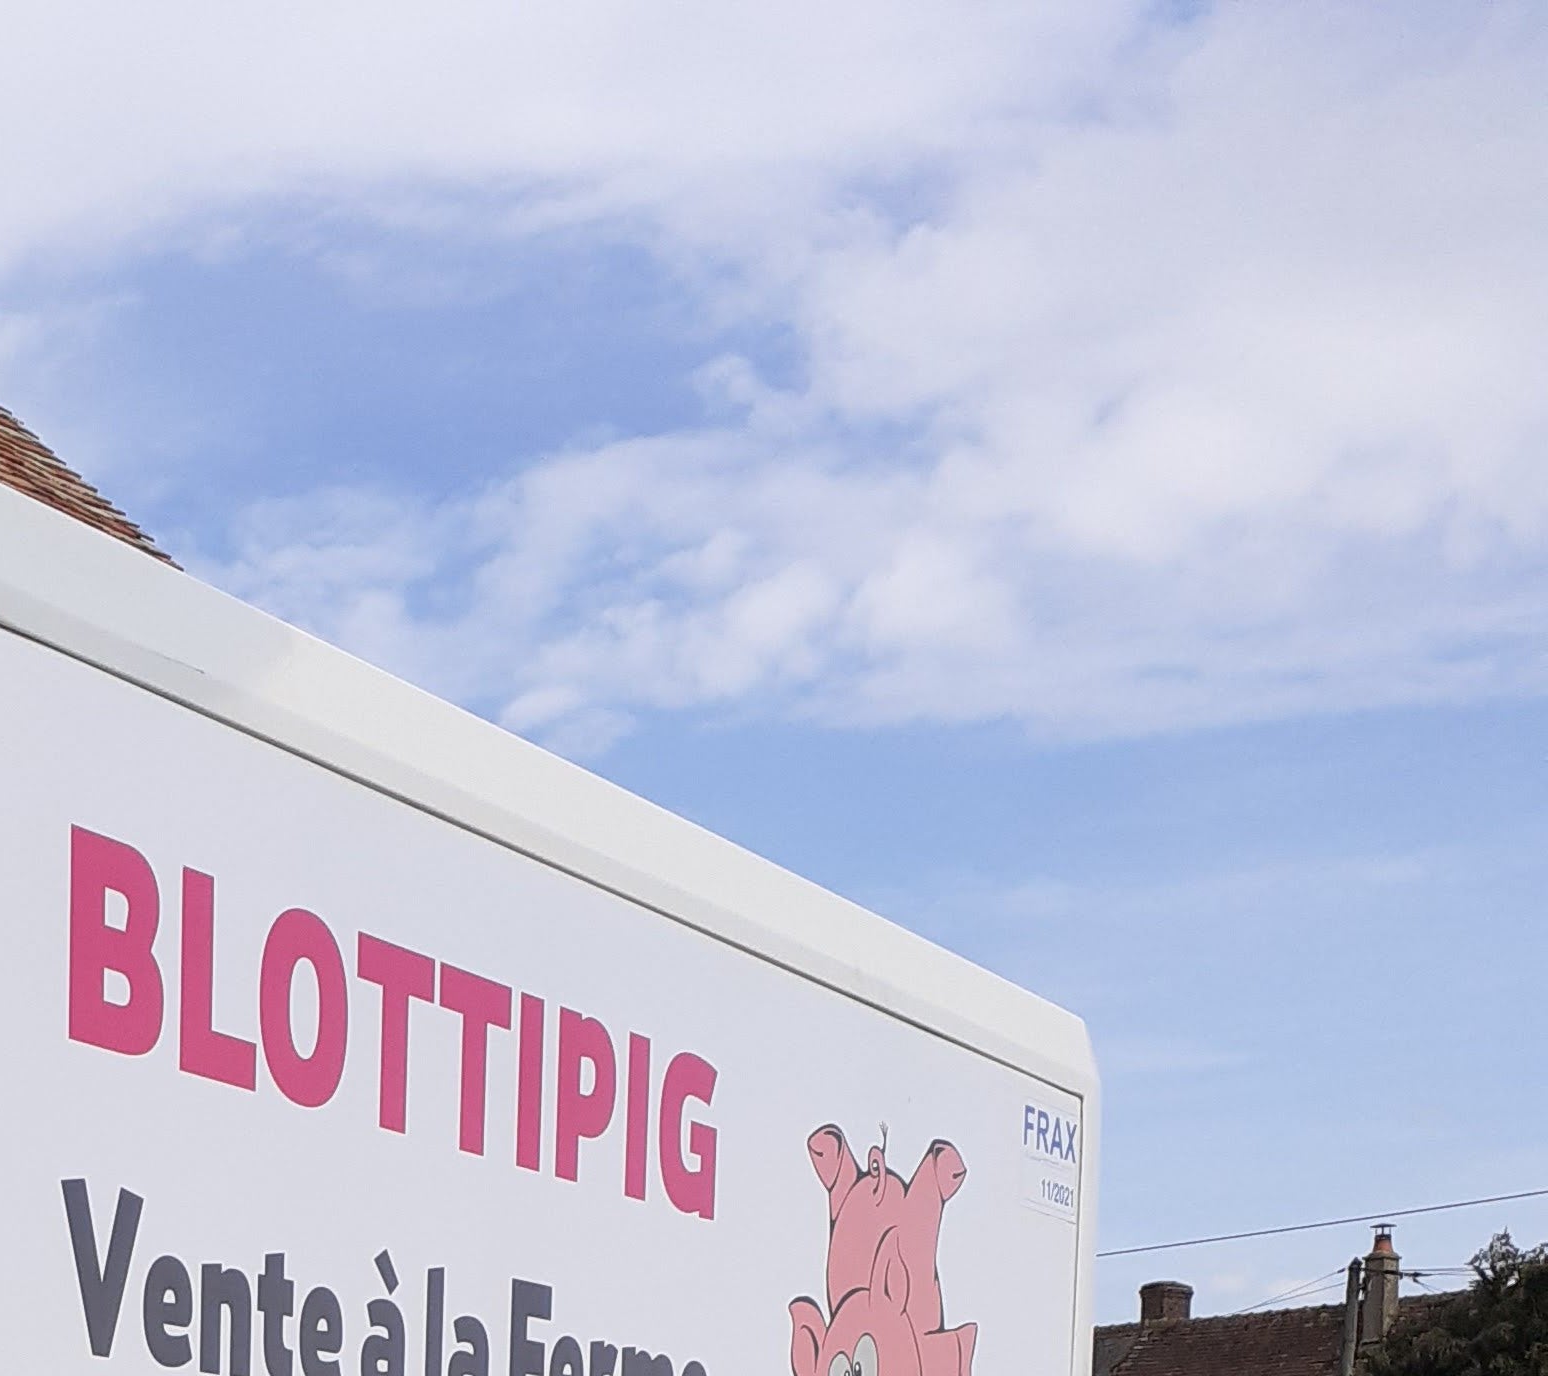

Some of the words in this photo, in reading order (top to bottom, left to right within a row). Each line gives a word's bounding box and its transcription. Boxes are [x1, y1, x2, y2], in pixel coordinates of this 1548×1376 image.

[68, 825, 718, 1220] BLOTTIPIG
[1023, 1104, 1077, 1164] FRAX
[1041, 1178, 1074, 1208] 11/2021
